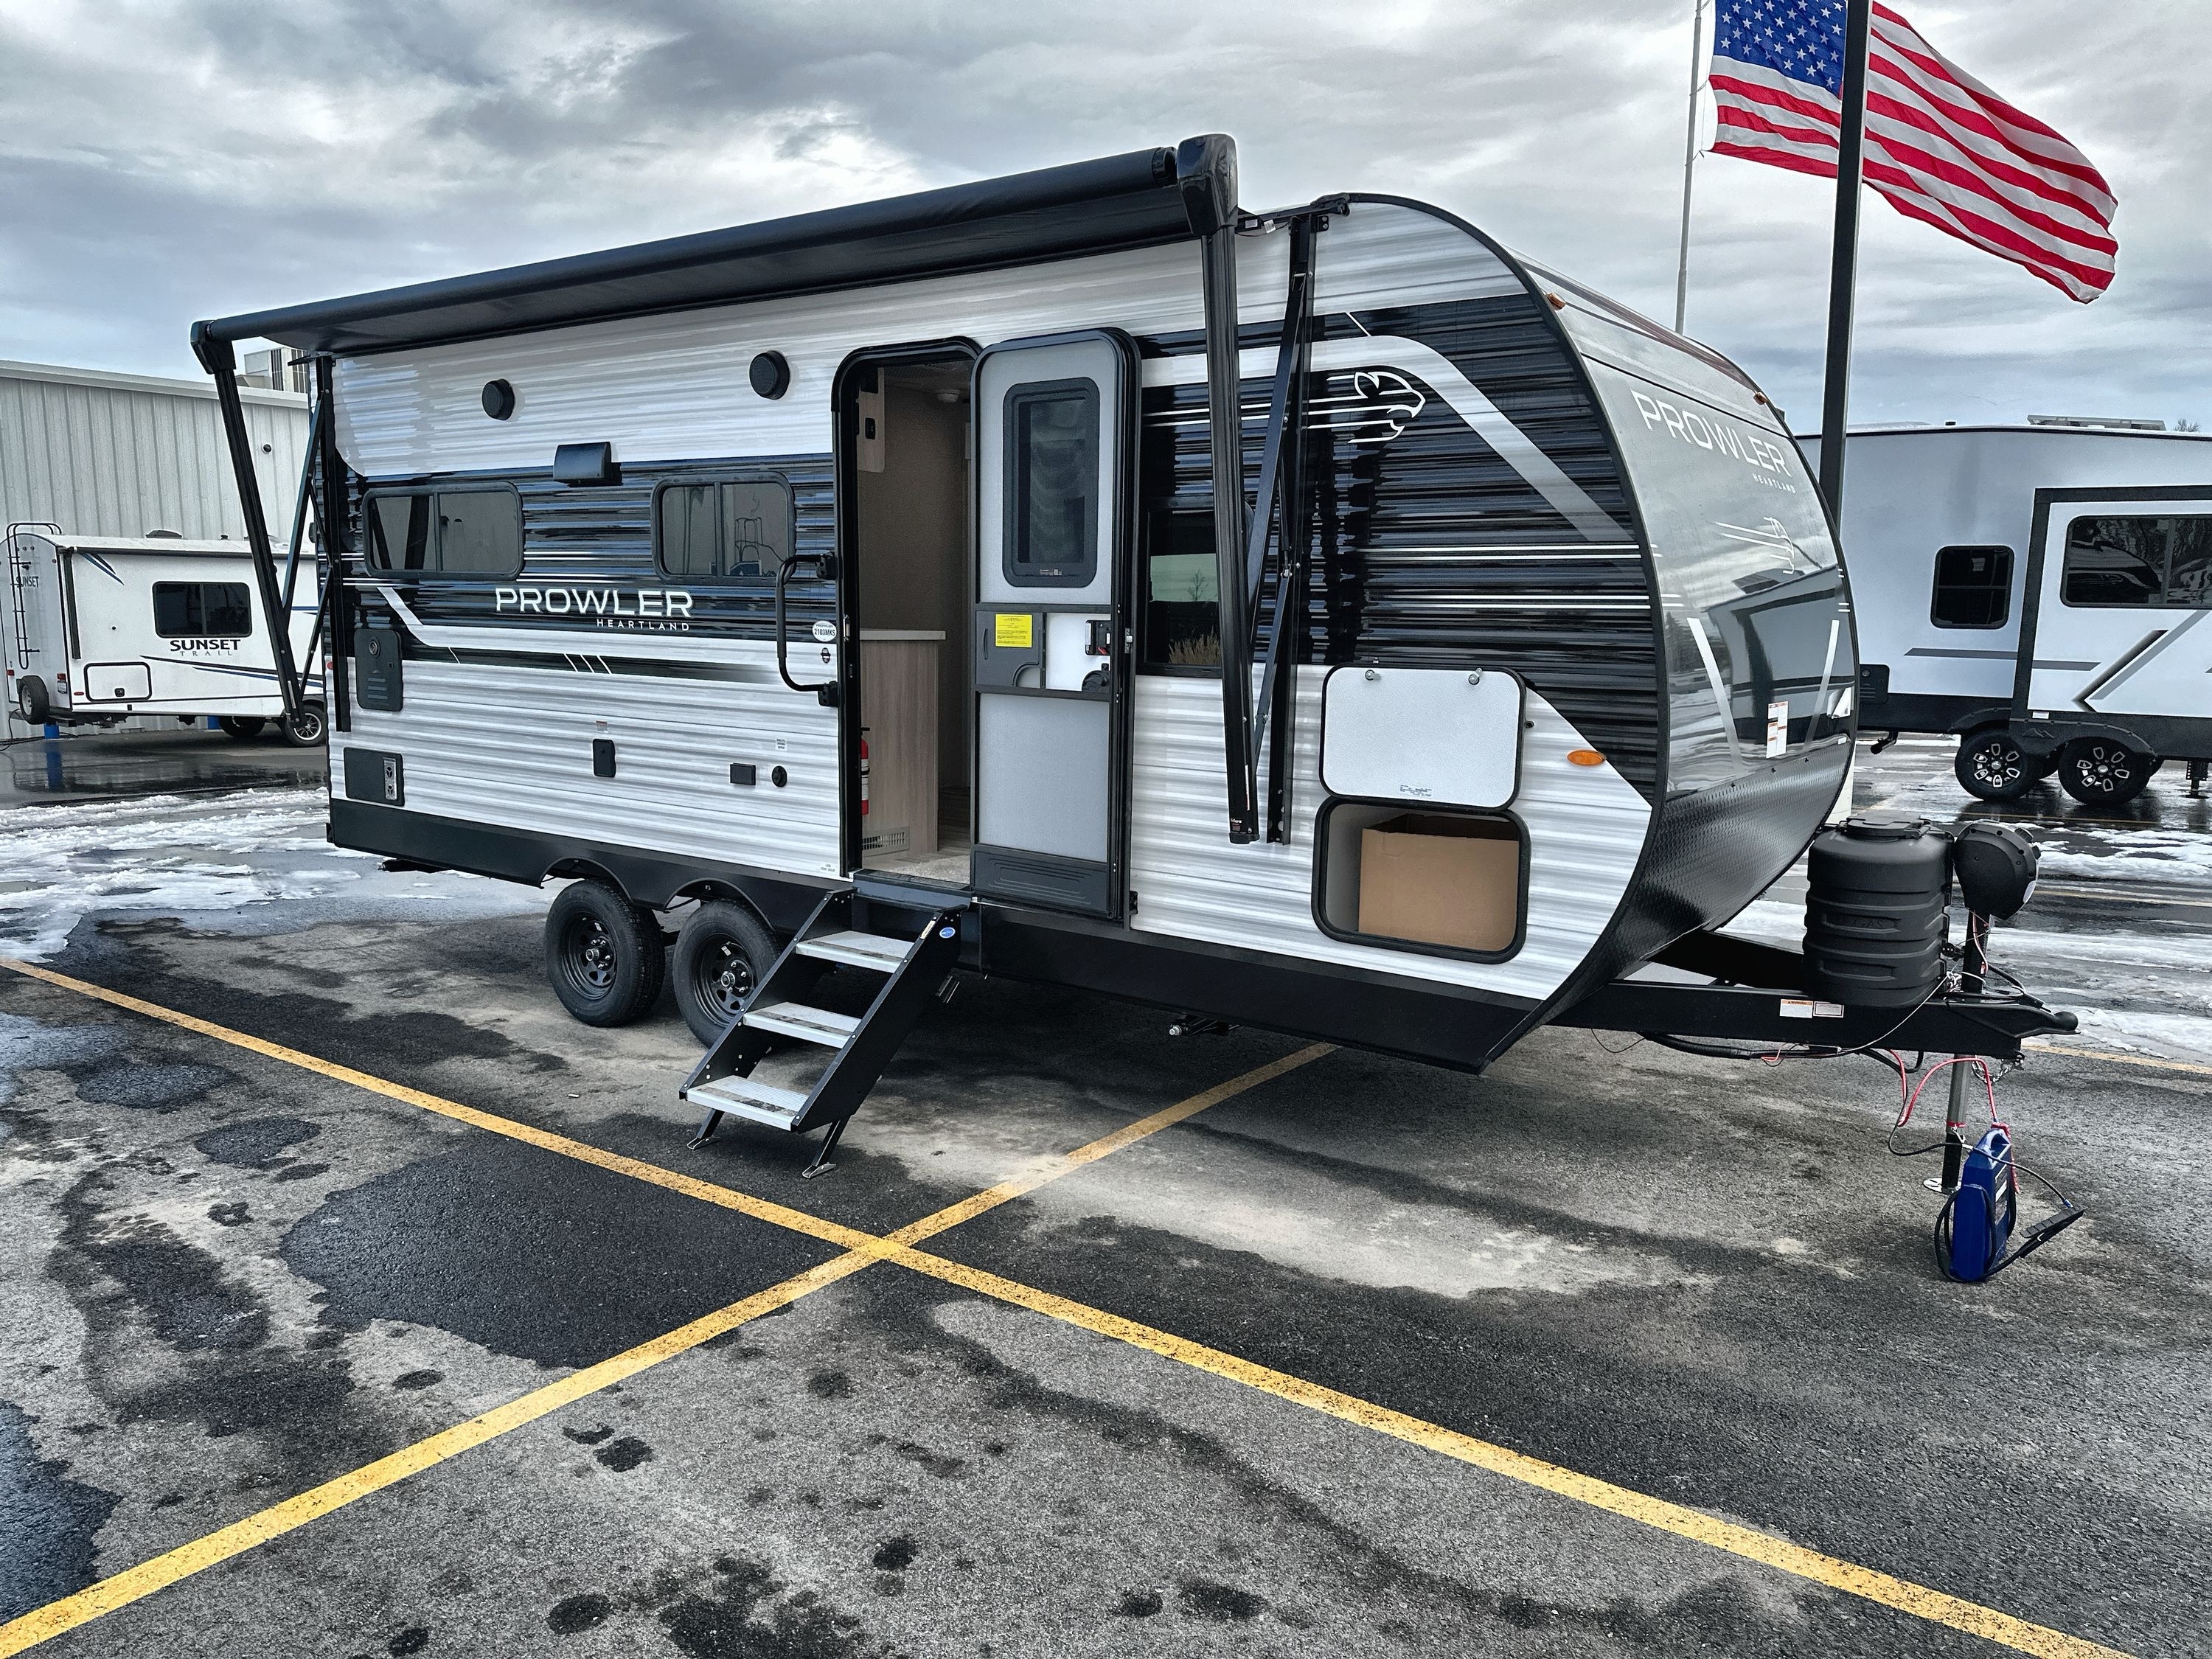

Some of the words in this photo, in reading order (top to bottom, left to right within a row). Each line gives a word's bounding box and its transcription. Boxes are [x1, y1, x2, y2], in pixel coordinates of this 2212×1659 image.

[1630, 389, 1792, 478] PROWLER
[1752, 473, 1797, 494] HEARTLAND
[495, 588, 693, 618] PROWLER
[597, 619, 689, 631] HEARTLAND
[170, 639, 241, 651] SUNSET
